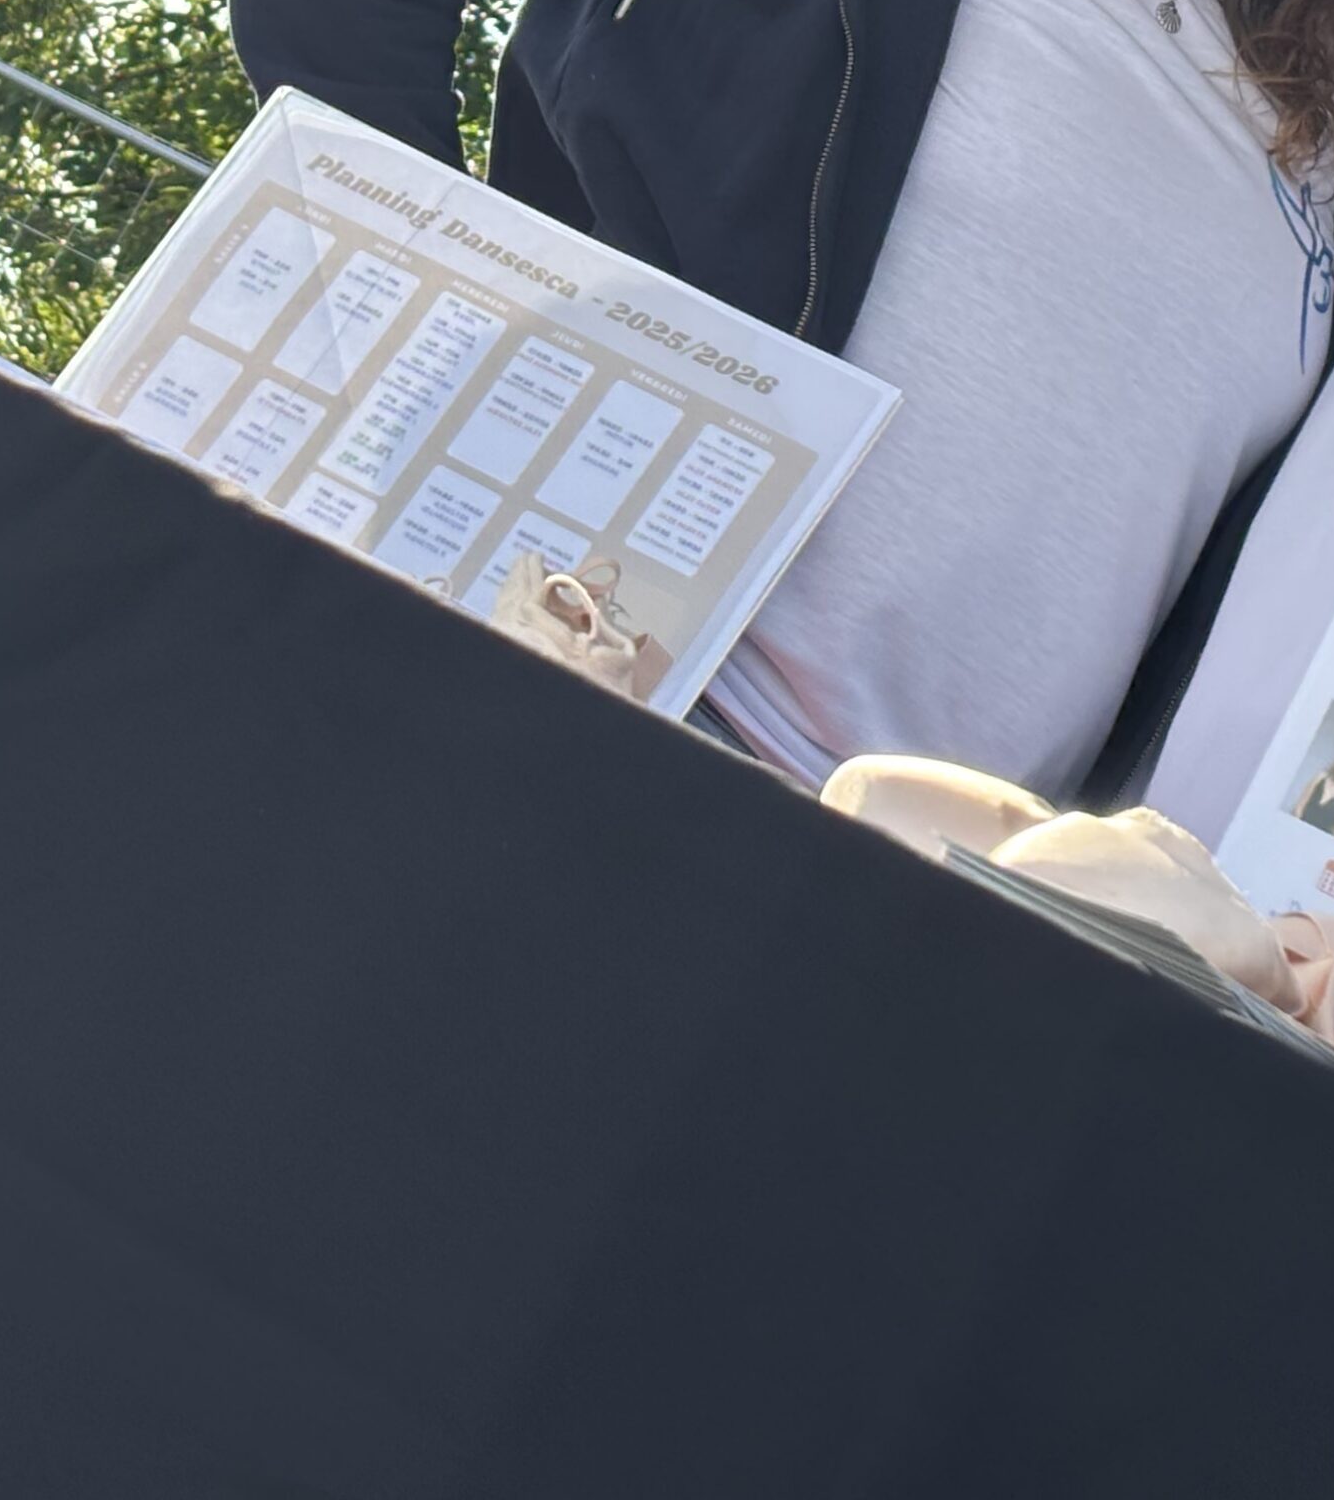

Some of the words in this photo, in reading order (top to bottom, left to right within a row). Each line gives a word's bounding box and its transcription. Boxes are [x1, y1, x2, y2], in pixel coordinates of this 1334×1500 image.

[305, 152, 441, 230] Planning
[440, 218, 583, 297] Dansesca
[606, 300, 779, 395] 2025/2026
